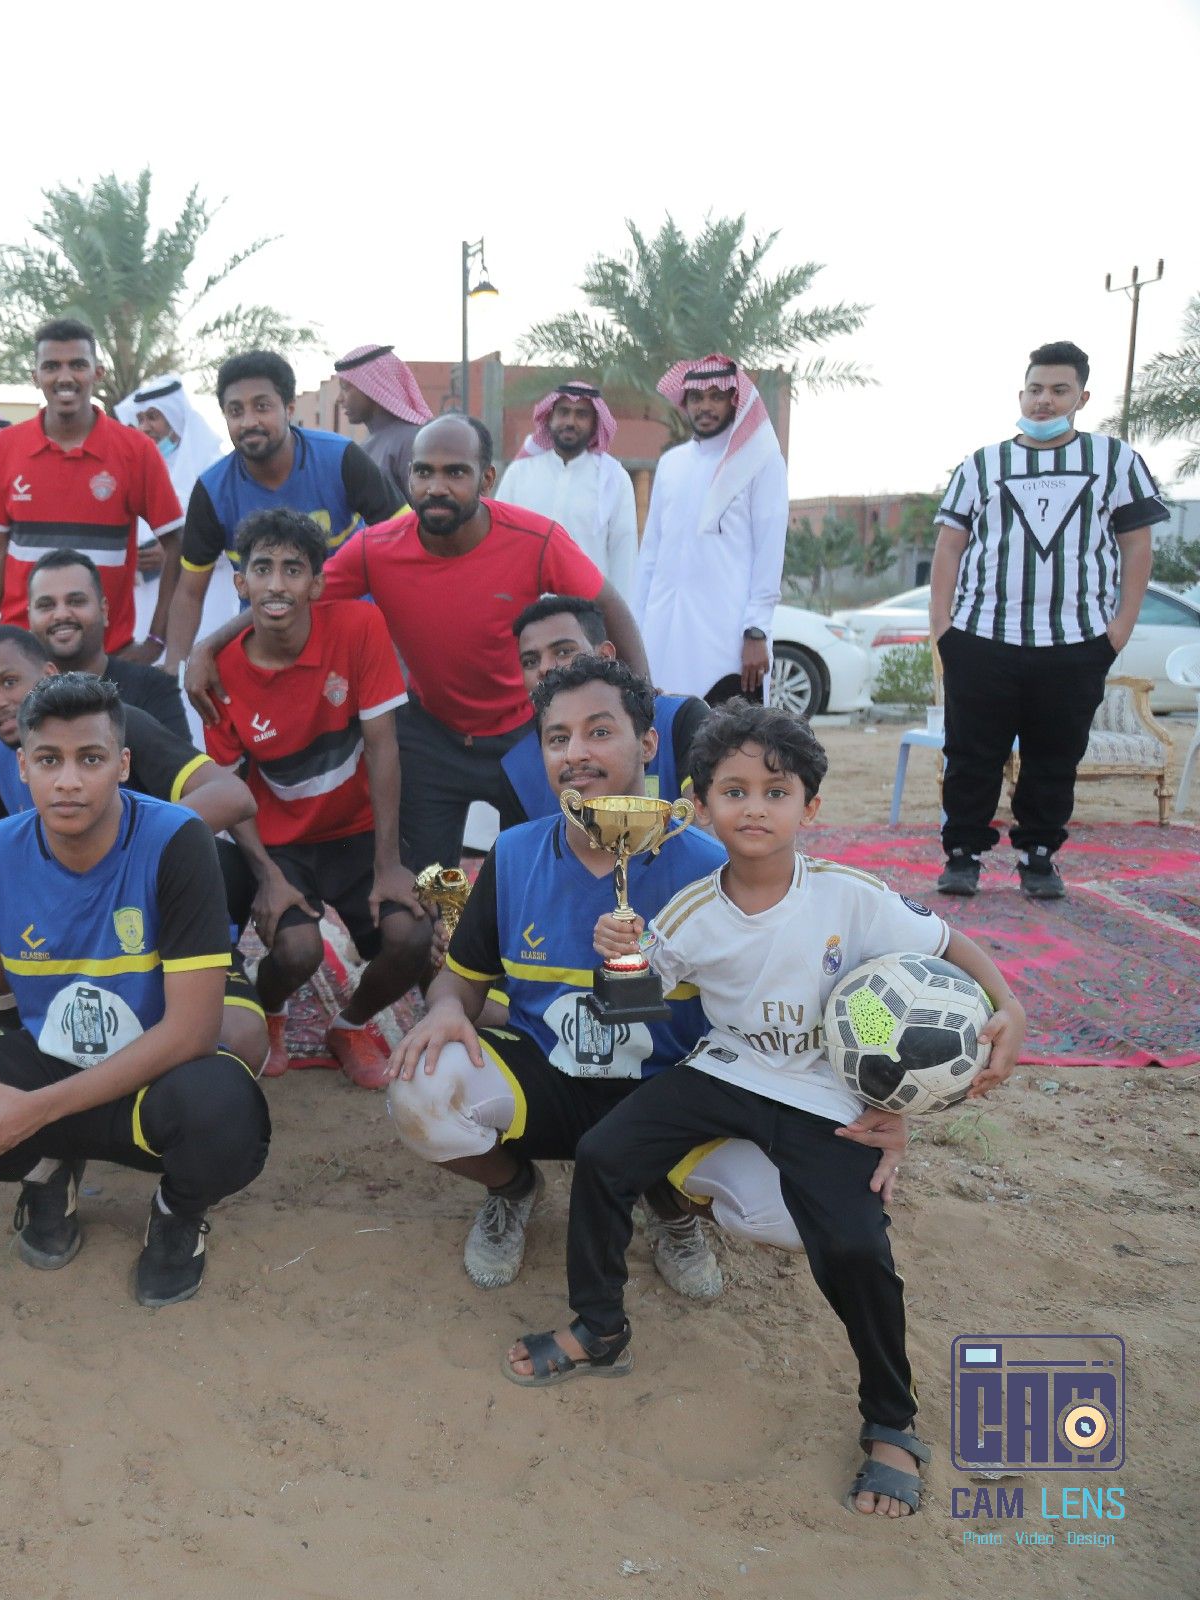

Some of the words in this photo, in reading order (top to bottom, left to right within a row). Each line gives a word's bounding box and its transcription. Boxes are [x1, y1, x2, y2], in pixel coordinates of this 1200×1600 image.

[20, 951, 50, 960] CLASSIC
[520, 950, 547, 961] CLASSIC
[762, 1001, 804, 1026] Fly
